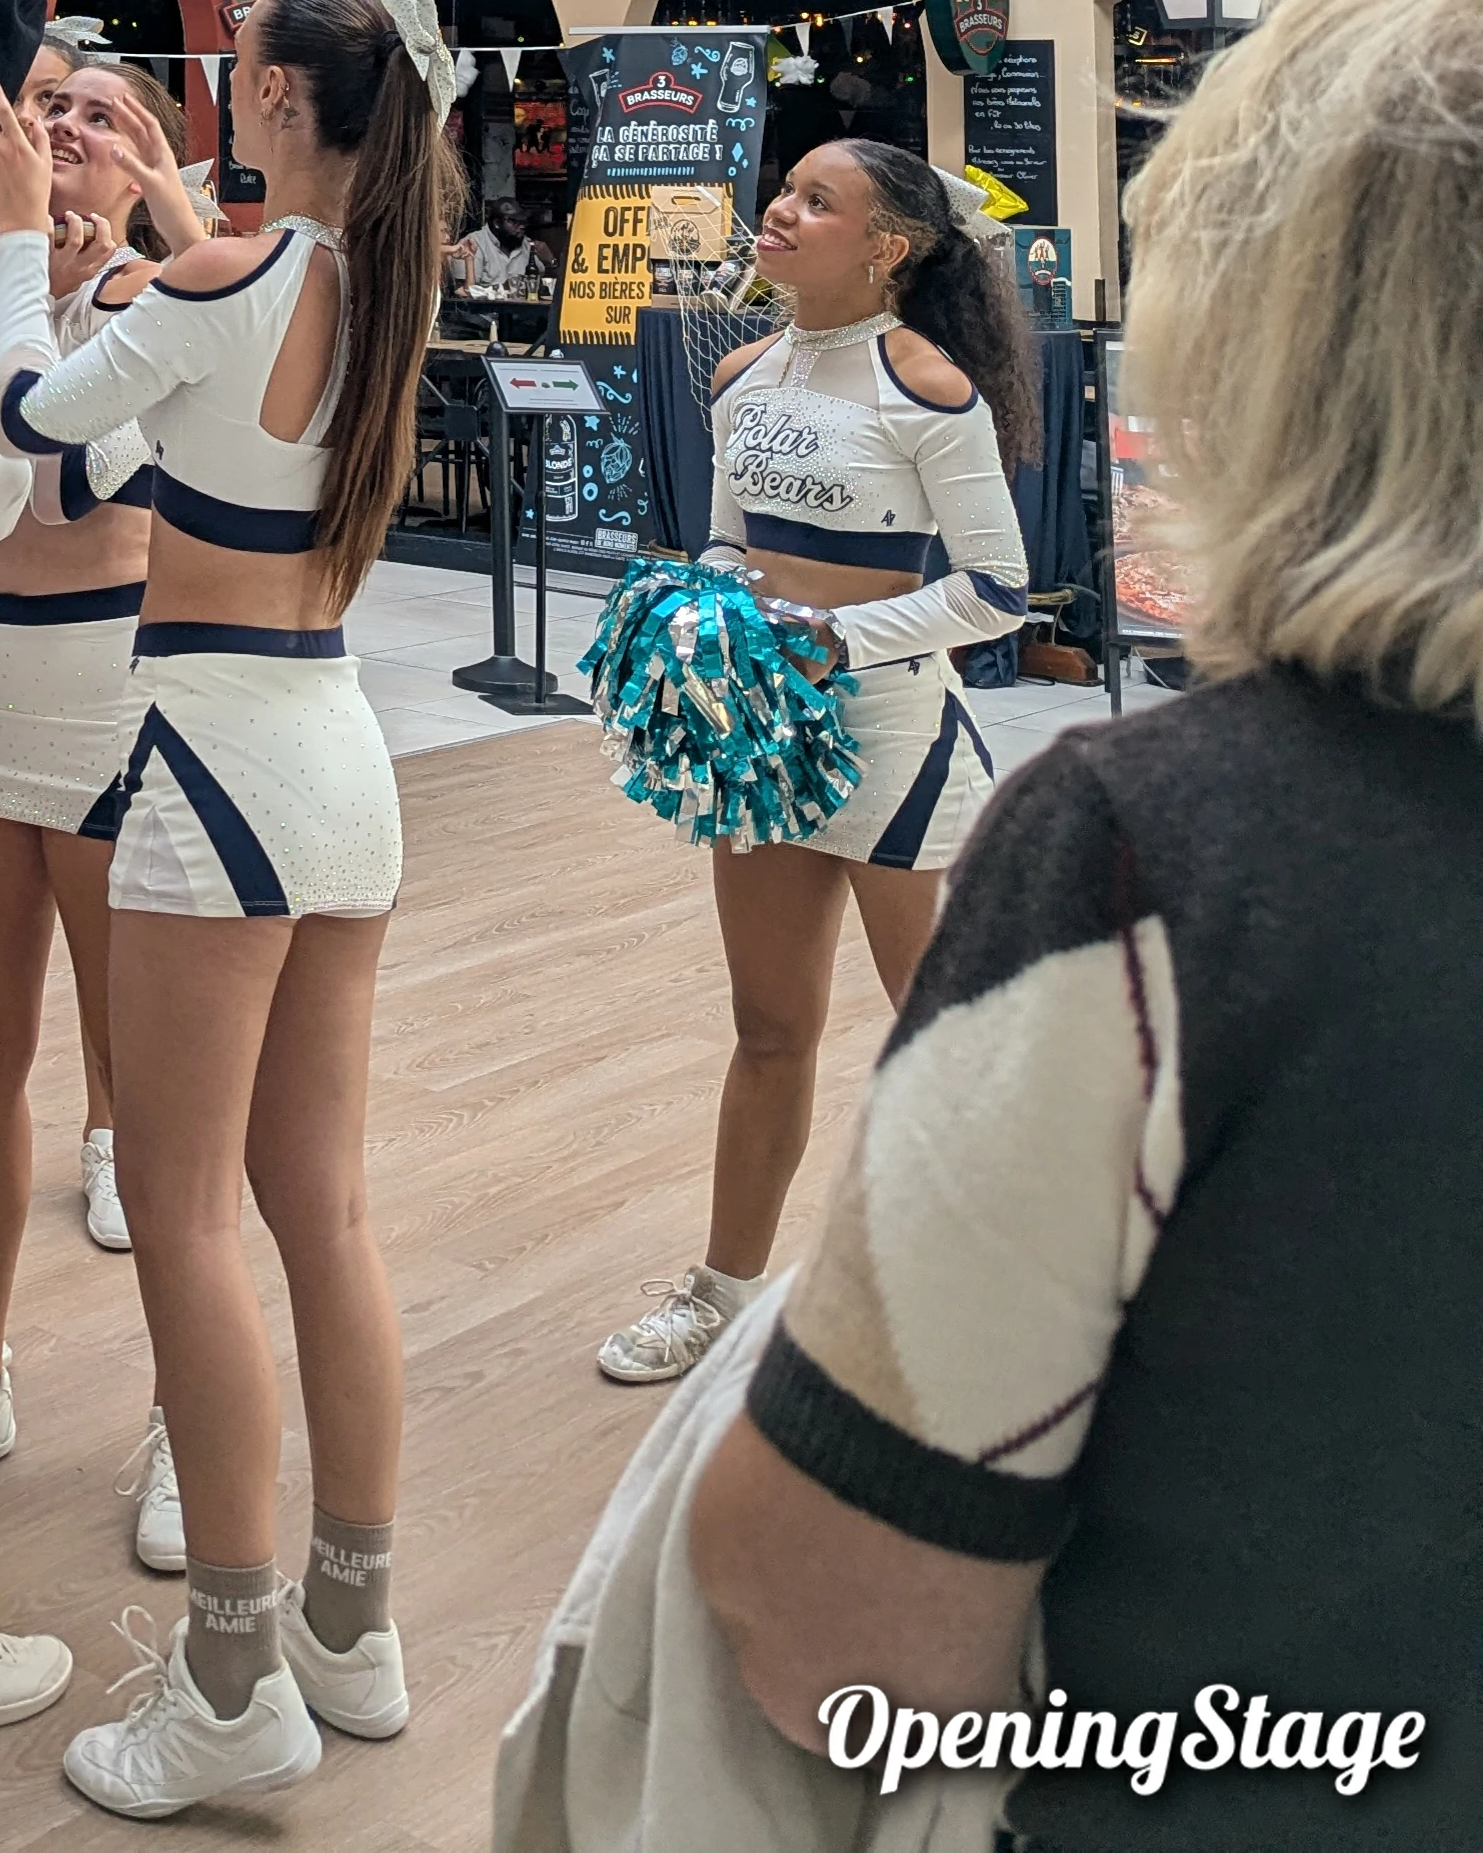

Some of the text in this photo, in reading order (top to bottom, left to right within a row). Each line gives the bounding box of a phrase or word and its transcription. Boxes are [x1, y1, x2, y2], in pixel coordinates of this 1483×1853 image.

[959, 13, 1003, 33] BRASSEURS
[657, 75, 666, 88] 3
[626, 89, 695, 106] BRASSEURS
[596, 126, 615, 144] LA
[619, 119, 719, 144] GÉNÉROSITÉ
[591, 144, 610, 169] ÇA
[614, 144, 635, 162] SE
[638, 143, 711, 162] PARTAGE
[571, 243, 588, 274] &
[568, 281, 595, 299] NOS
[599, 277, 645, 300] BIÈRES
[605, 306, 631, 325] SUR
[726, 403, 820, 458] Polar
[727, 448, 854, 512] Bears
[597, 529, 637, 544] BRASSEURS
[320, 1560, 367, 1587] AMIE
[205, 1613, 257, 1634] AMIE
